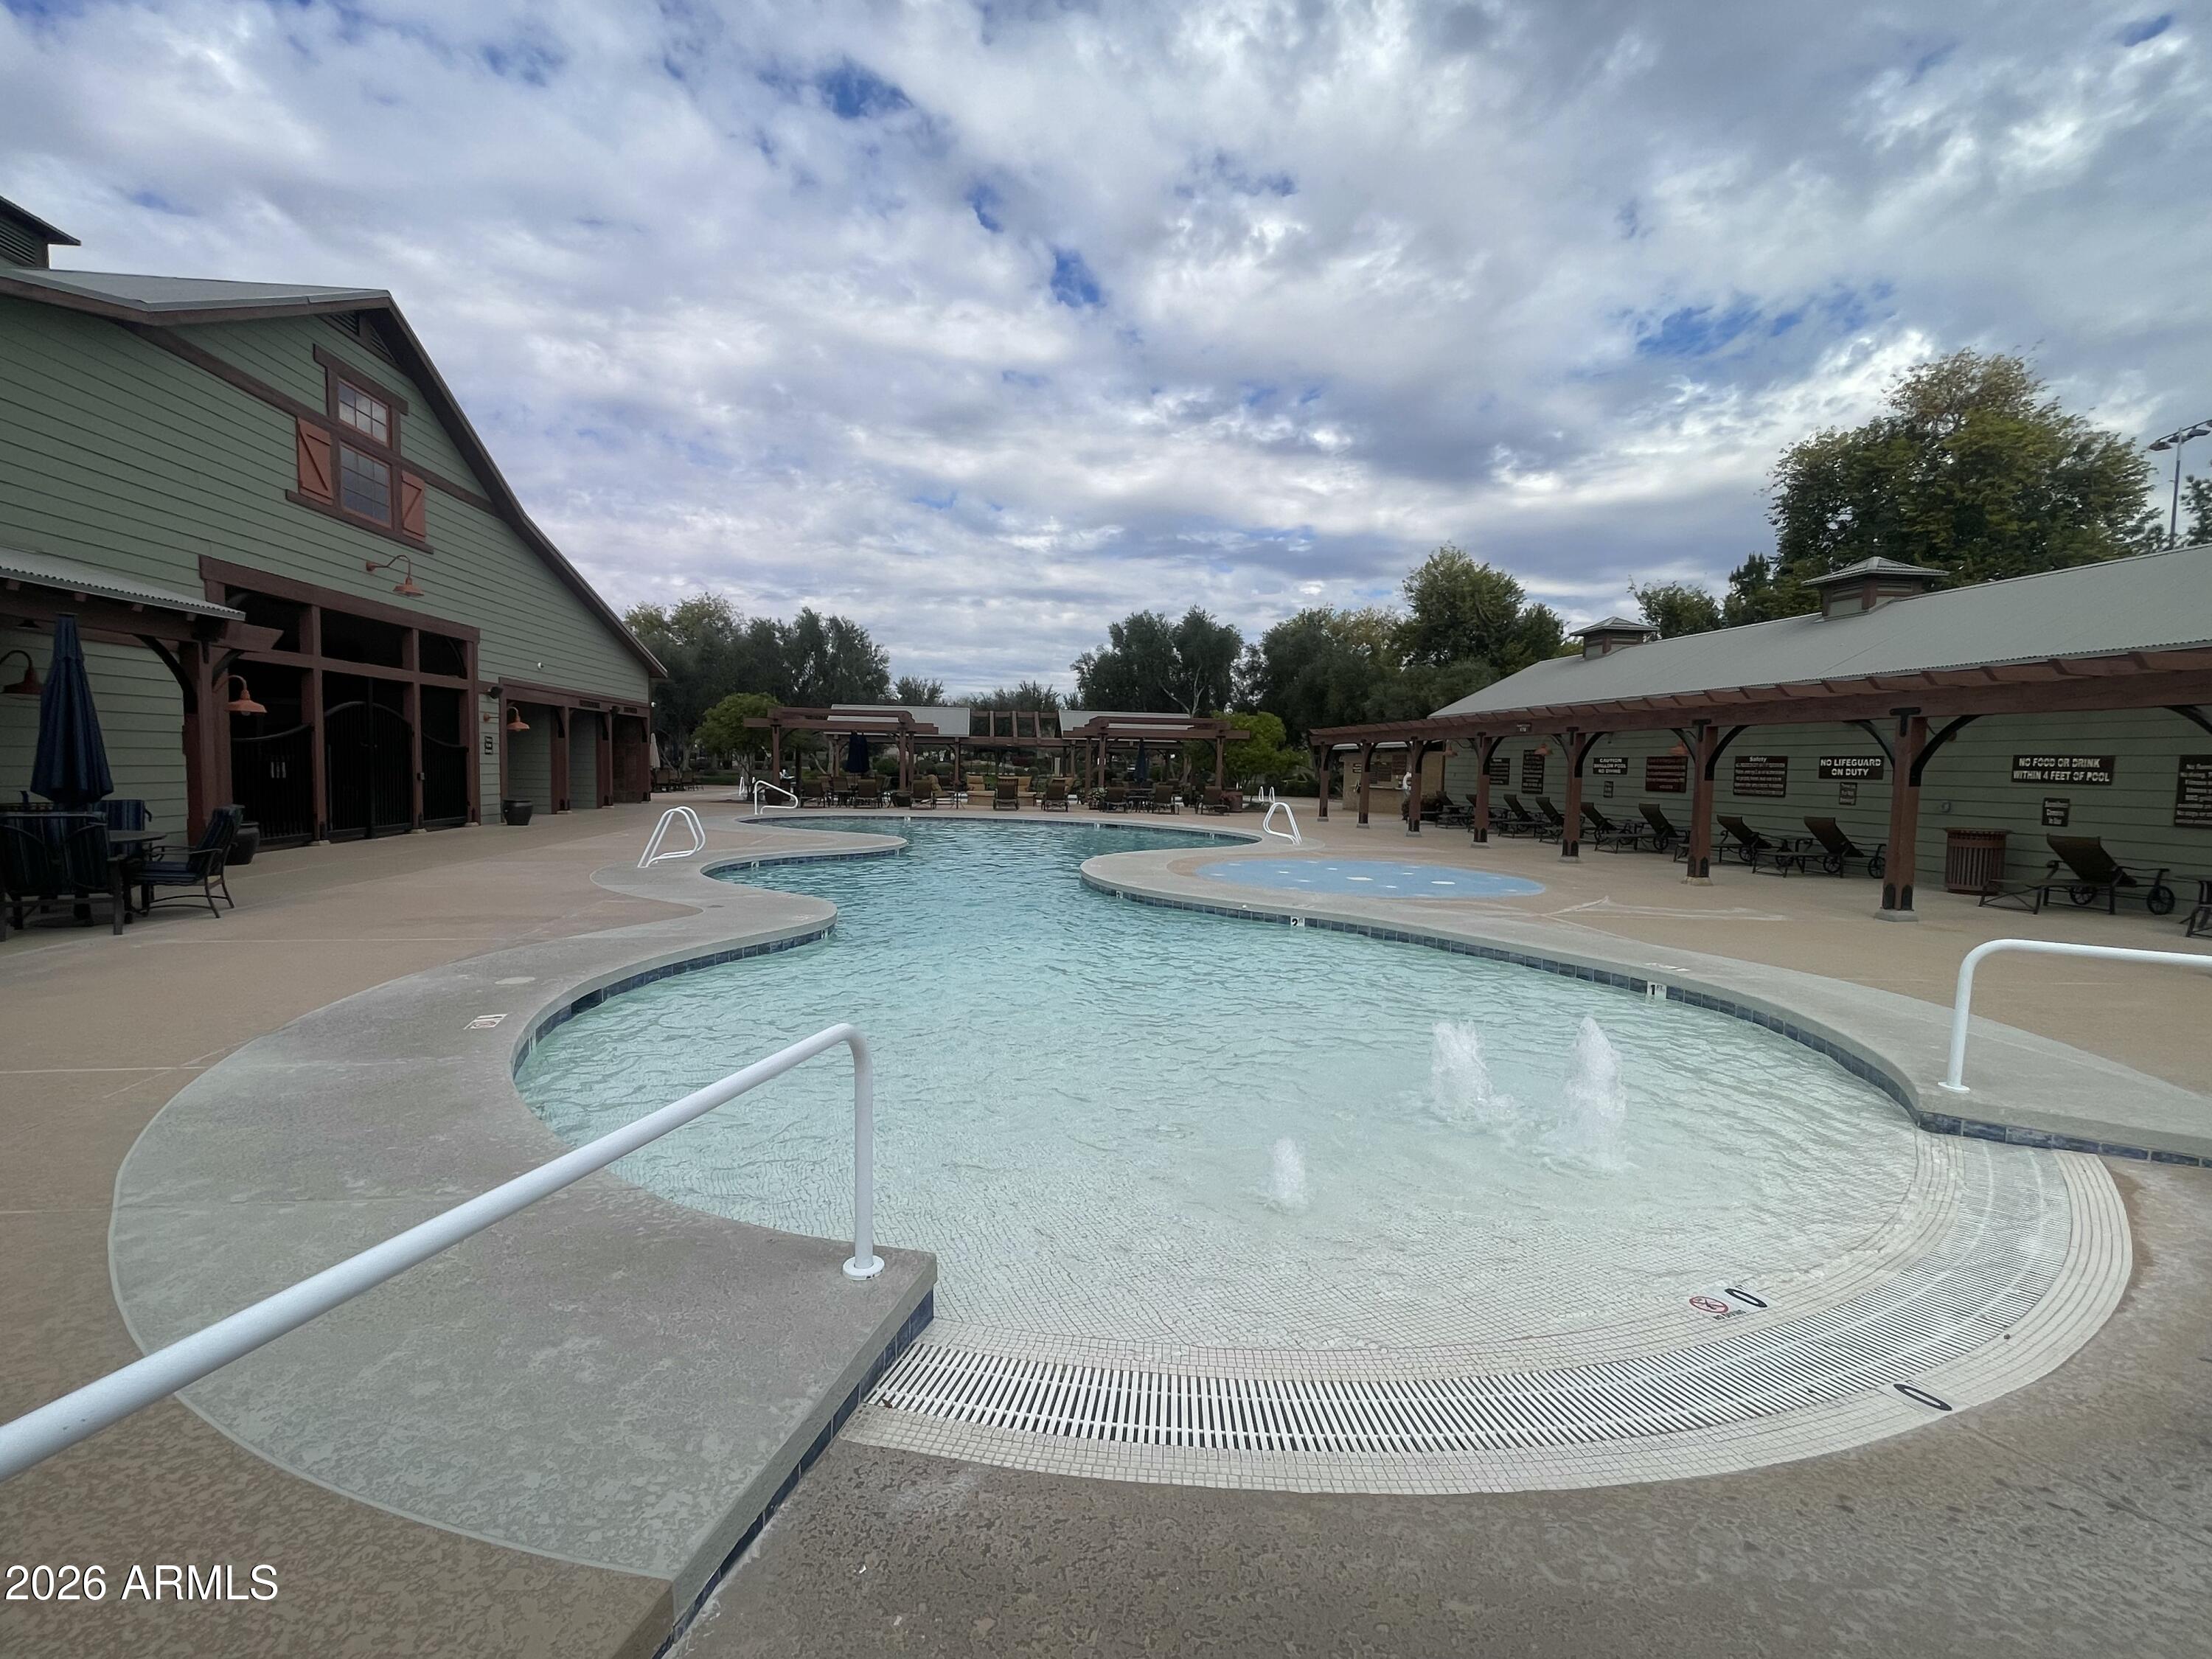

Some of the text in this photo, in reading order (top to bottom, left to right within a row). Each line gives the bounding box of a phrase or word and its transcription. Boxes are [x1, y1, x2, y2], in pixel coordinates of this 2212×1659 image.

[1834, 759, 1882, 767] LIFEGUARD
[2018, 758, 2101, 768] NO FOOD OR DRINK
[1845, 768, 1869, 776] DUTY
[2013, 771, 2110, 782] WITHIN 4 FEET OF POOL
[1650, 984, 1655, 995] 1
[1724, 1288, 1767, 1308] 0
[1893, 1383, 1952, 1411] 0
